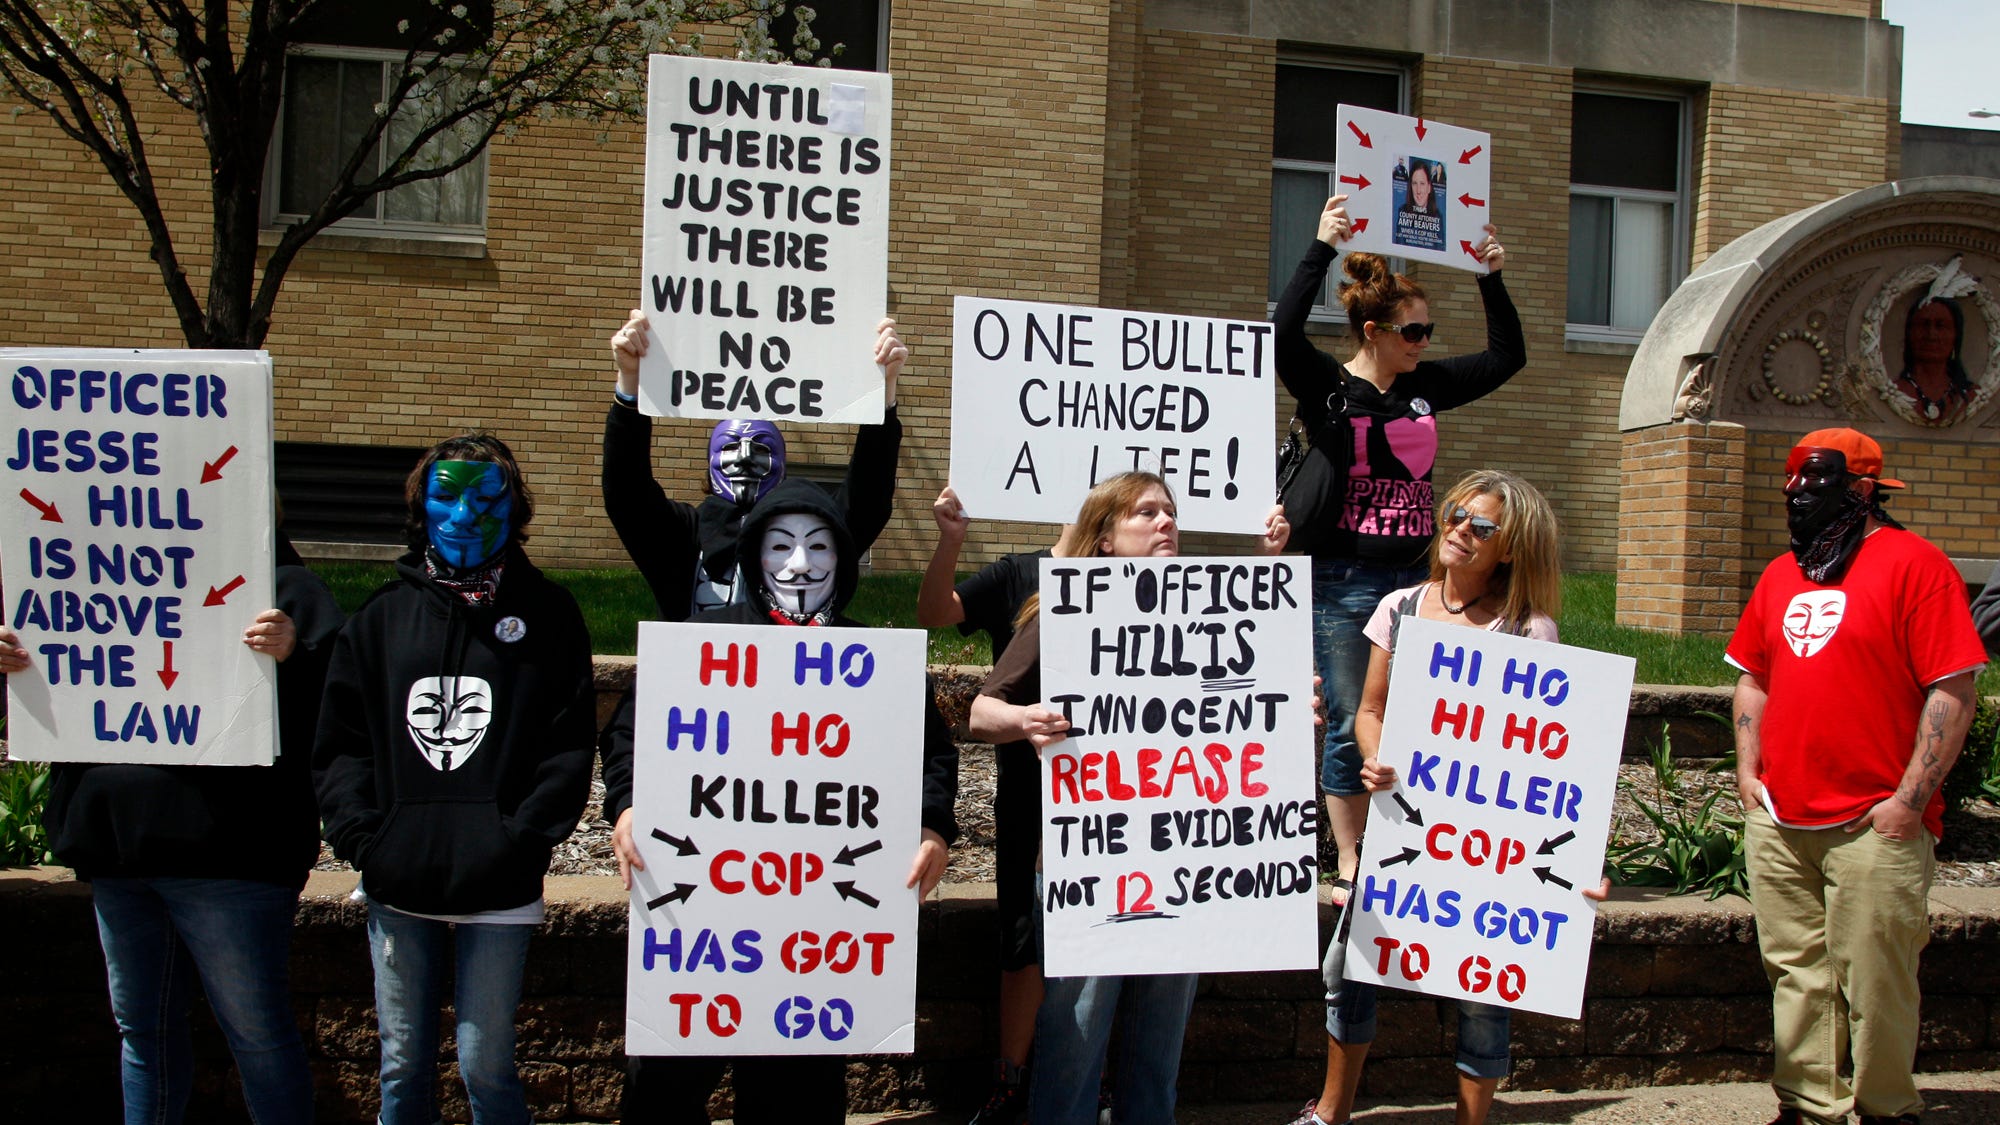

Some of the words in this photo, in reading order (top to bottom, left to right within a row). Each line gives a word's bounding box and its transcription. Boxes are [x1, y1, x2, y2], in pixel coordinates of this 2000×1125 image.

[689, 77, 828, 124] UNTIL
[670, 123, 823, 173] THERE
[840, 138, 881, 174] IS
[662, 173, 860, 225] JUSTICE
[1398, 218, 1413, 227] AMY
[1413, 220, 1440, 231] BEAVERS
[1399, 211, 1417, 219] COUNTY
[1417, 214, 1440, 224] ATTORNEY
[680, 223, 828, 271] THERE
[652, 275, 759, 318] WILL
[777, 285, 835, 324] BE
[719, 331, 790, 372] NO
[973, 309, 1094, 367] ONE
[1122, 317, 1271, 378] BULLET
[13, 365, 227, 418] OFFICER
[671, 370, 823, 417] PEACE
[1019, 379, 1209, 433] CHANGED
[7, 428, 160, 475] JESSE
[1005, 441, 1041, 494] A
[1349, 416, 1372, 476] I
[88, 485, 203, 530] HILL
[1337, 503, 1433, 536] NATION
[29, 537, 76, 579] IS
[88, 544, 194, 589] NOT
[14, 589, 182, 638] ABOVE
[1051, 567, 1111, 615] IF
[1123, 563, 1297, 615] "OFFICER
[39, 644, 135, 687] THE
[700, 642, 757, 687] HI
[795, 641, 874, 688] HO
[1429, 642, 1482, 686] HI
[1502, 658, 1569, 706] HO
[94, 700, 200, 745] LAW
[667, 706, 729, 755] HI
[771, 712, 850, 757] HO
[1050, 694, 1289, 737] INNOCENT
[1431, 698, 1485, 742] HI
[1503, 713, 1569, 760] HO
[1051, 743, 1269, 804] RELEASE
[1408, 751, 1582, 822] KILLER
[690, 774, 879, 829] KILLER
[1051, 813, 1129, 857] THE
[1151, 800, 1317, 852] EVIDENCE
[1426, 823, 1525, 874] COP
[709, 850, 824, 896] COP
[1047, 876, 1099, 913] NOT
[1117, 871, 1155, 914] 12
[1166, 855, 1317, 906] SECONDS
[1362, 875, 1461, 928] HAS
[1473, 901, 1568, 950] GOT
[643, 928, 763, 973] HAS
[780, 930, 894, 976] GOT
[1373, 937, 1430, 982] TO
[1458, 955, 1526, 1002] GO
[669, 993, 741, 1038] TO
[774, 996, 853, 1041] GO
